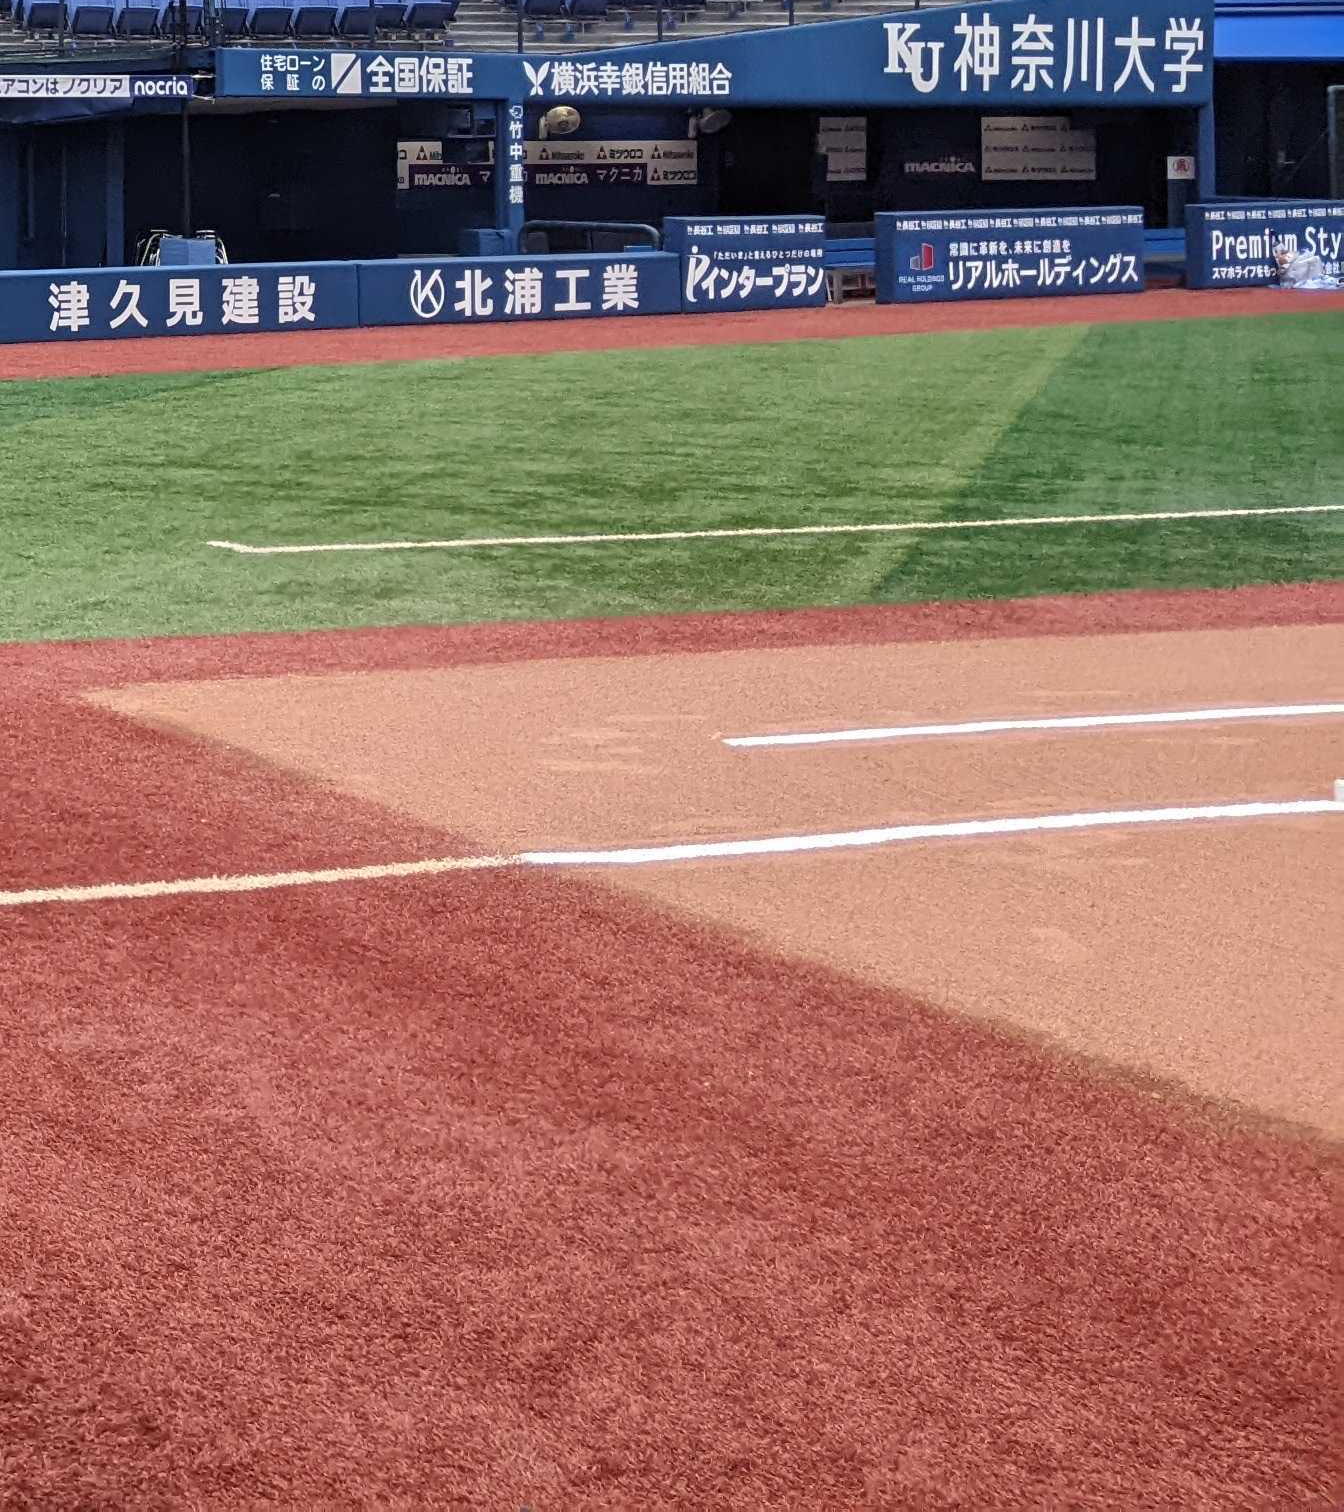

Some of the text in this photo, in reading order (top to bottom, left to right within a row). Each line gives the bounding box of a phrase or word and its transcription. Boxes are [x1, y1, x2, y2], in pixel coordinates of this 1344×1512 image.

[260, 54, 326, 72] 住宅ローン
[953, 11, 1204, 93] 神奈川大学
[134, 76, 188, 96] nocria
[366, 55, 474, 94] 全国保証
[550, 61, 733, 97] 横浜幸銀信用組合
[509, 119, 524, 205] 竹中重機
[454, 263, 640, 317] 北浦工業
[701, 263, 824, 300] インタープラン
[948, 253, 1139, 290] リアルホールディングス
[48, 275, 317, 332] 津久見建設
